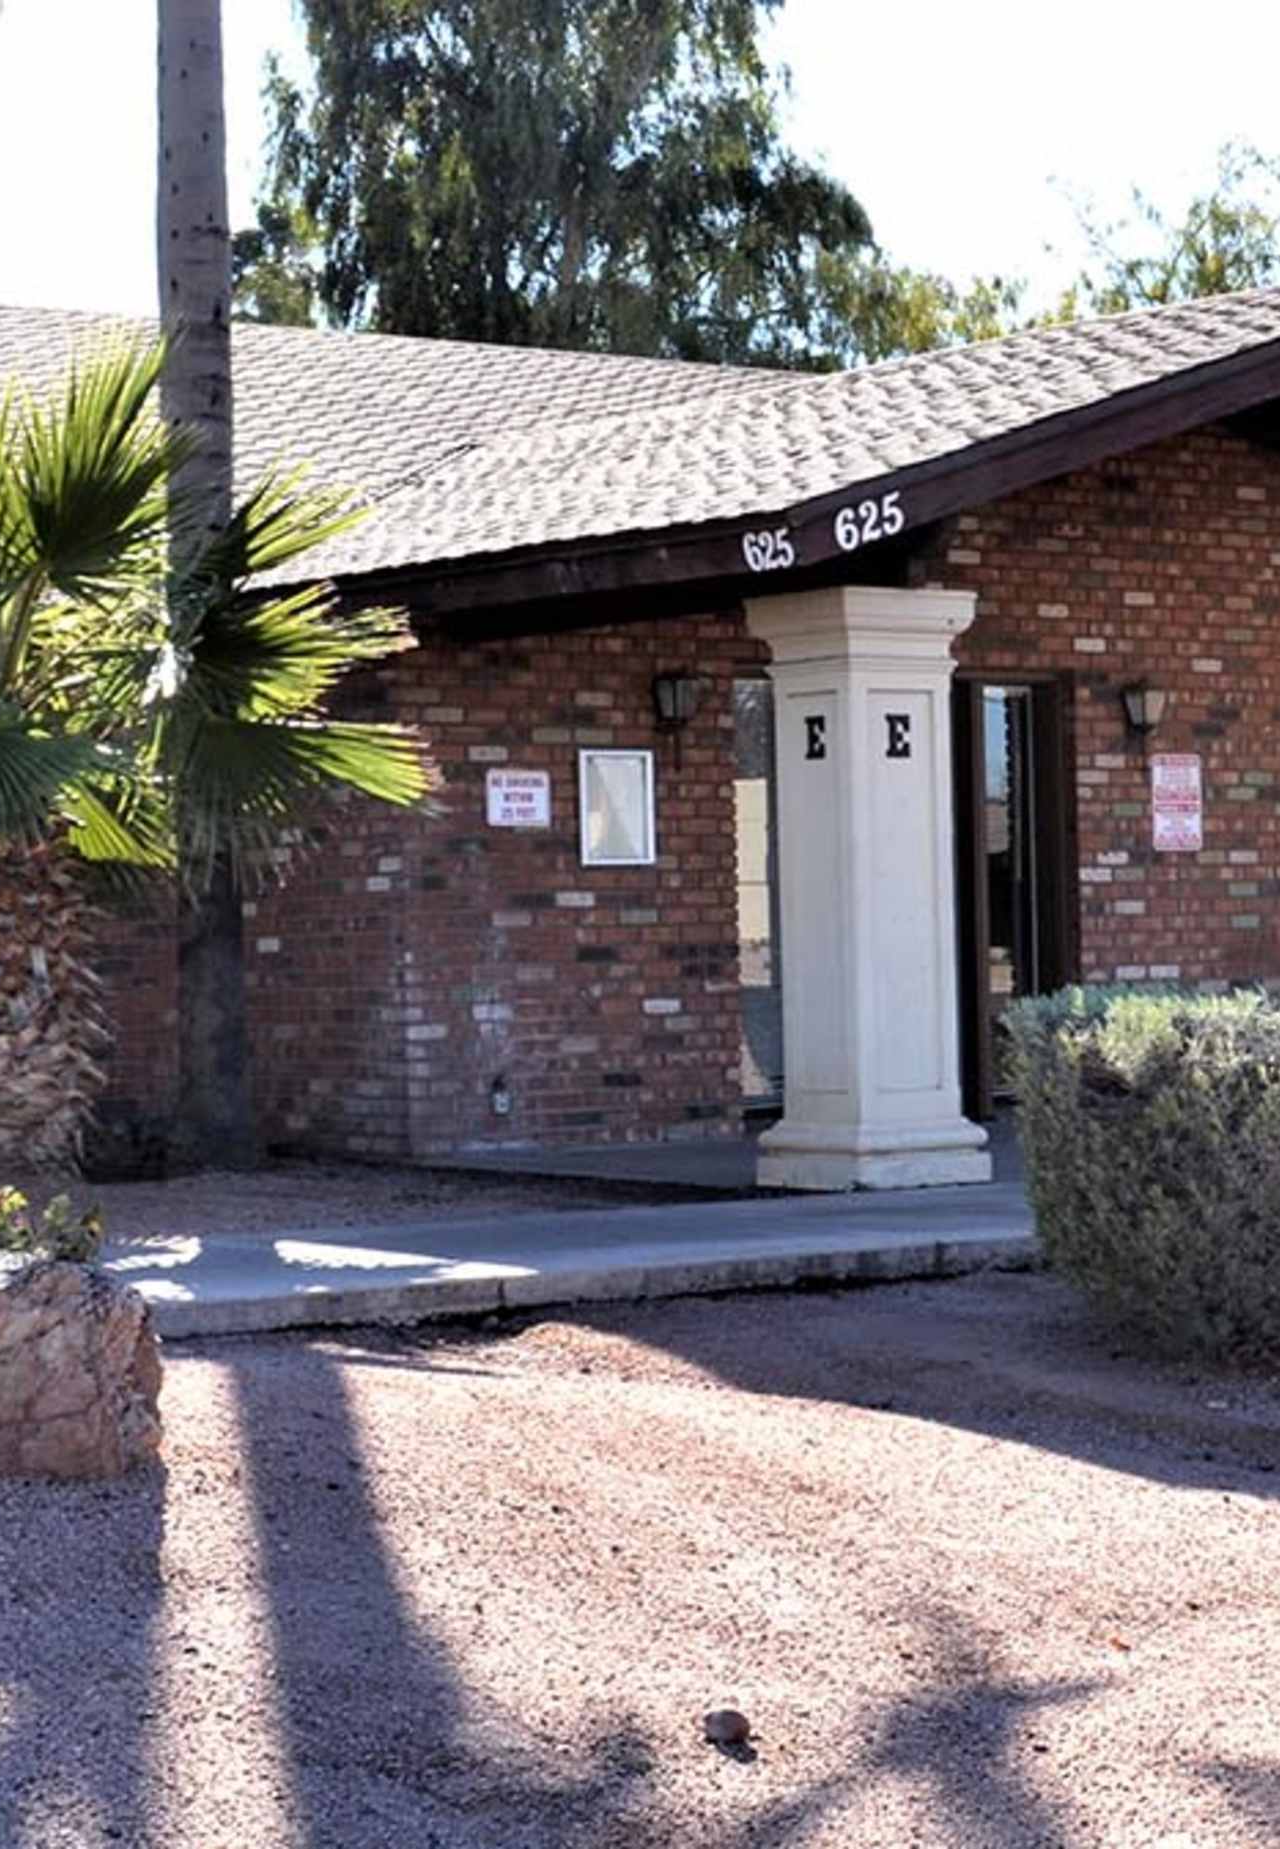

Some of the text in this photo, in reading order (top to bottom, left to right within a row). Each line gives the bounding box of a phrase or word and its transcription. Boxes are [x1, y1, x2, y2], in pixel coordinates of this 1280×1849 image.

[835, 491, 905, 551] 625
[742, 527, 795, 572] 625
[804, 715, 826, 760] E
[885, 714, 911, 758] E
